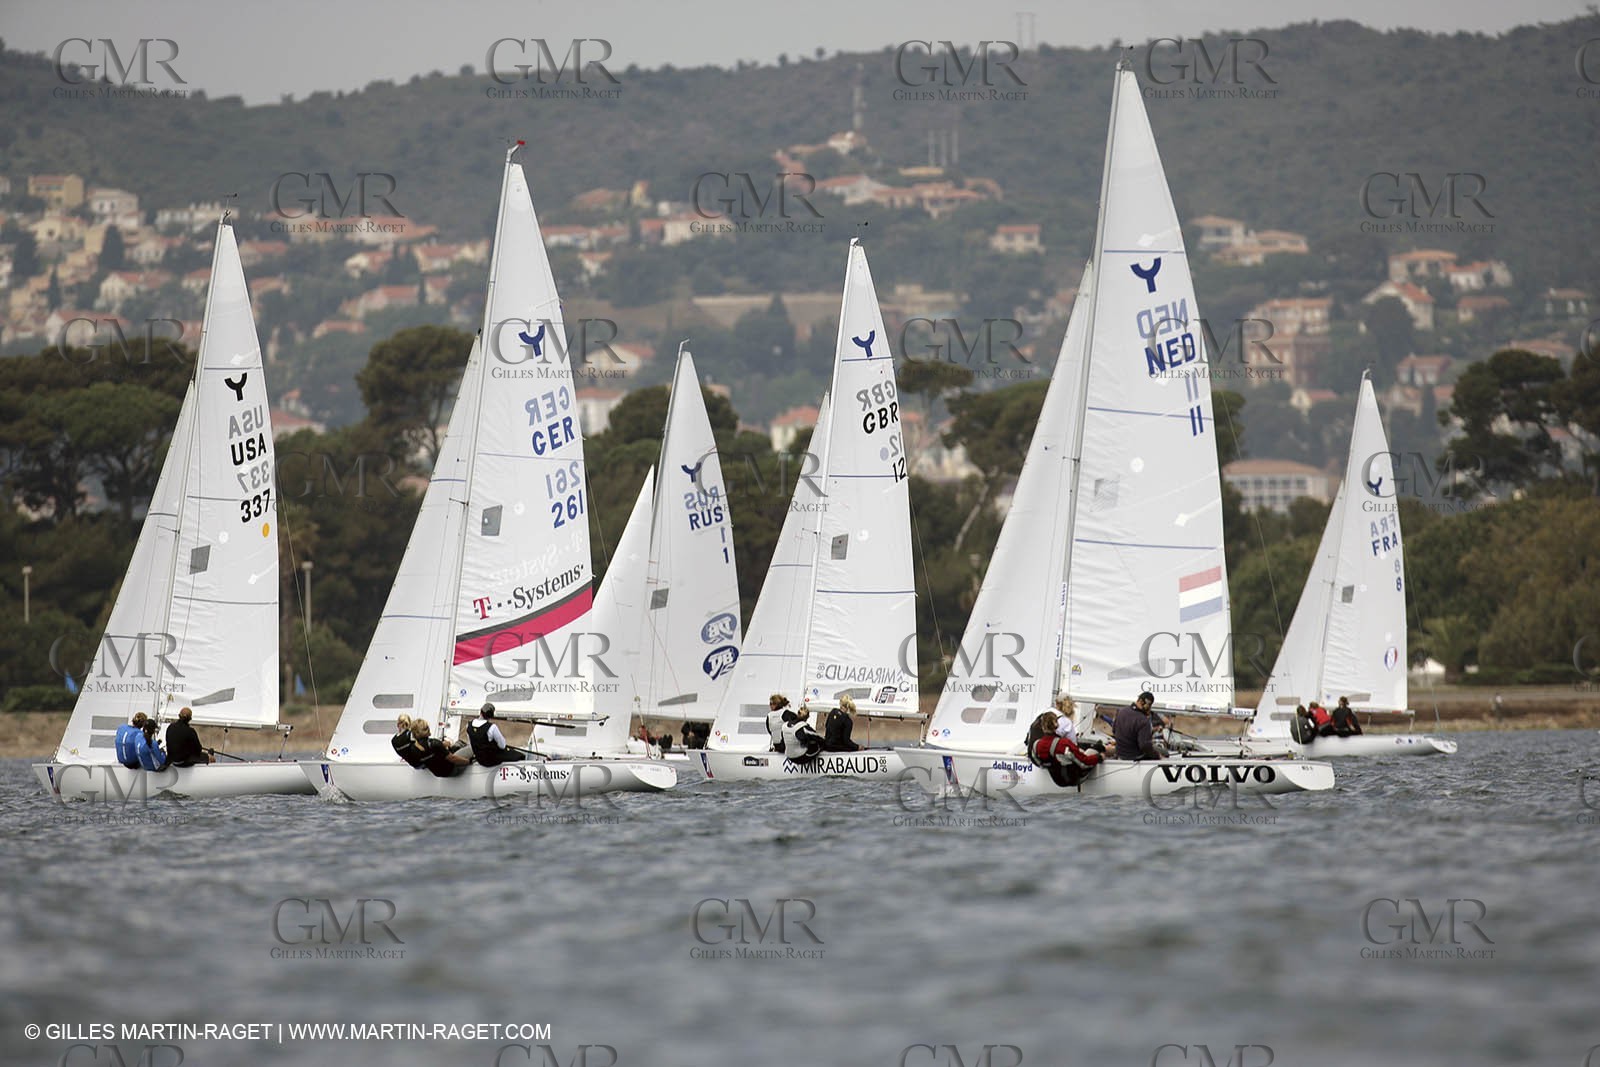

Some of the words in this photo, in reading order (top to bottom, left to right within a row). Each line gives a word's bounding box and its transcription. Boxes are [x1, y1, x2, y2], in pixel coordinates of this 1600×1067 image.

[1144, 332, 1196, 376] NED
[863, 402, 898, 434] GBR
[1190, 405, 1204, 436] 11
[532, 416, 575, 456] GER
[231, 433, 267, 466] USA
[892, 457, 906, 483] 12
[240, 488, 270, 523] 337
[551, 490, 584, 528] 261
[689, 506, 724, 530] RUS
[722, 547, 729, 564] 1
[1372, 532, 1398, 556] FRA
[1396, 576, 1402, 592] 8
[800, 757, 878, 774] MIRABAUD
[1013, 762, 1032, 773] lloyd
[1158, 764, 1276, 784] VOLVO
